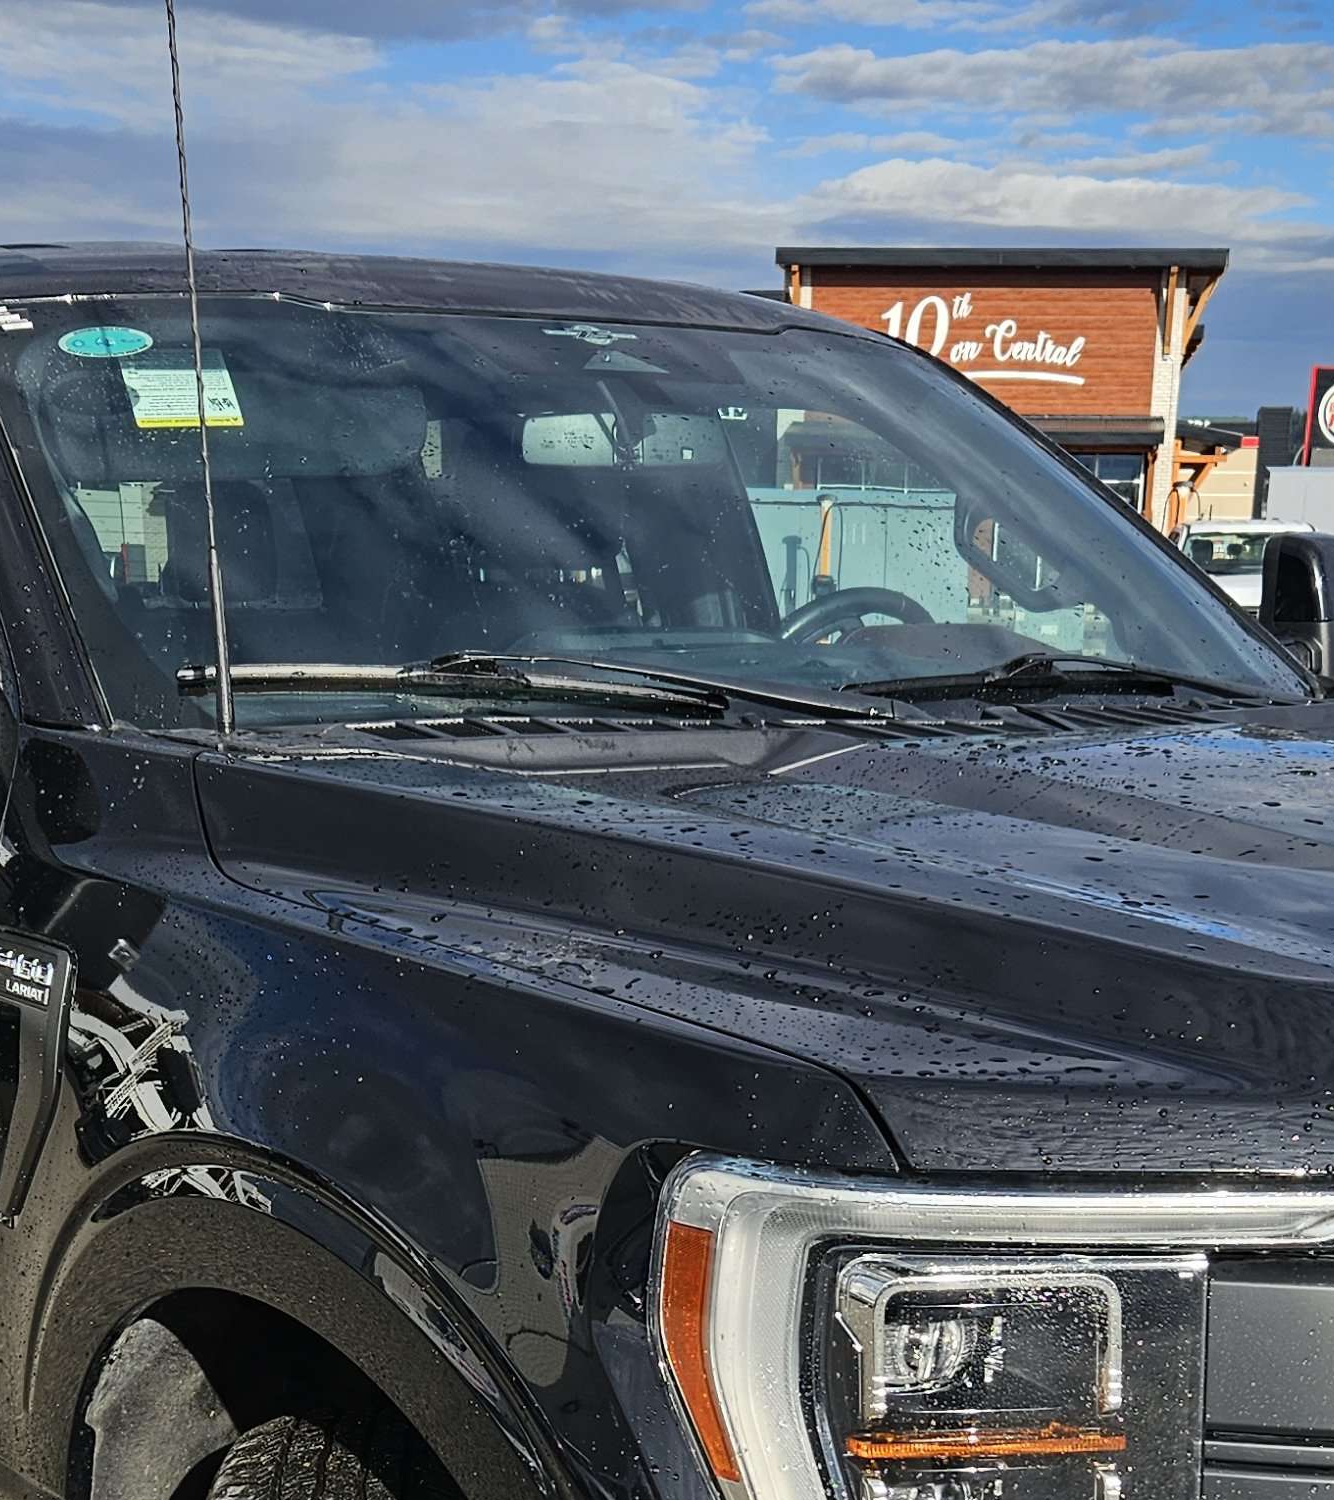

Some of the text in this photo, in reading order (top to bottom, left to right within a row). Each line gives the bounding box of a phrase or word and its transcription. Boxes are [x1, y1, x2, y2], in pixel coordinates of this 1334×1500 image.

[950, 341, 981, 363] on
[984, 319, 1086, 367] Central
[5, 979, 45, 1002] LARIAT
